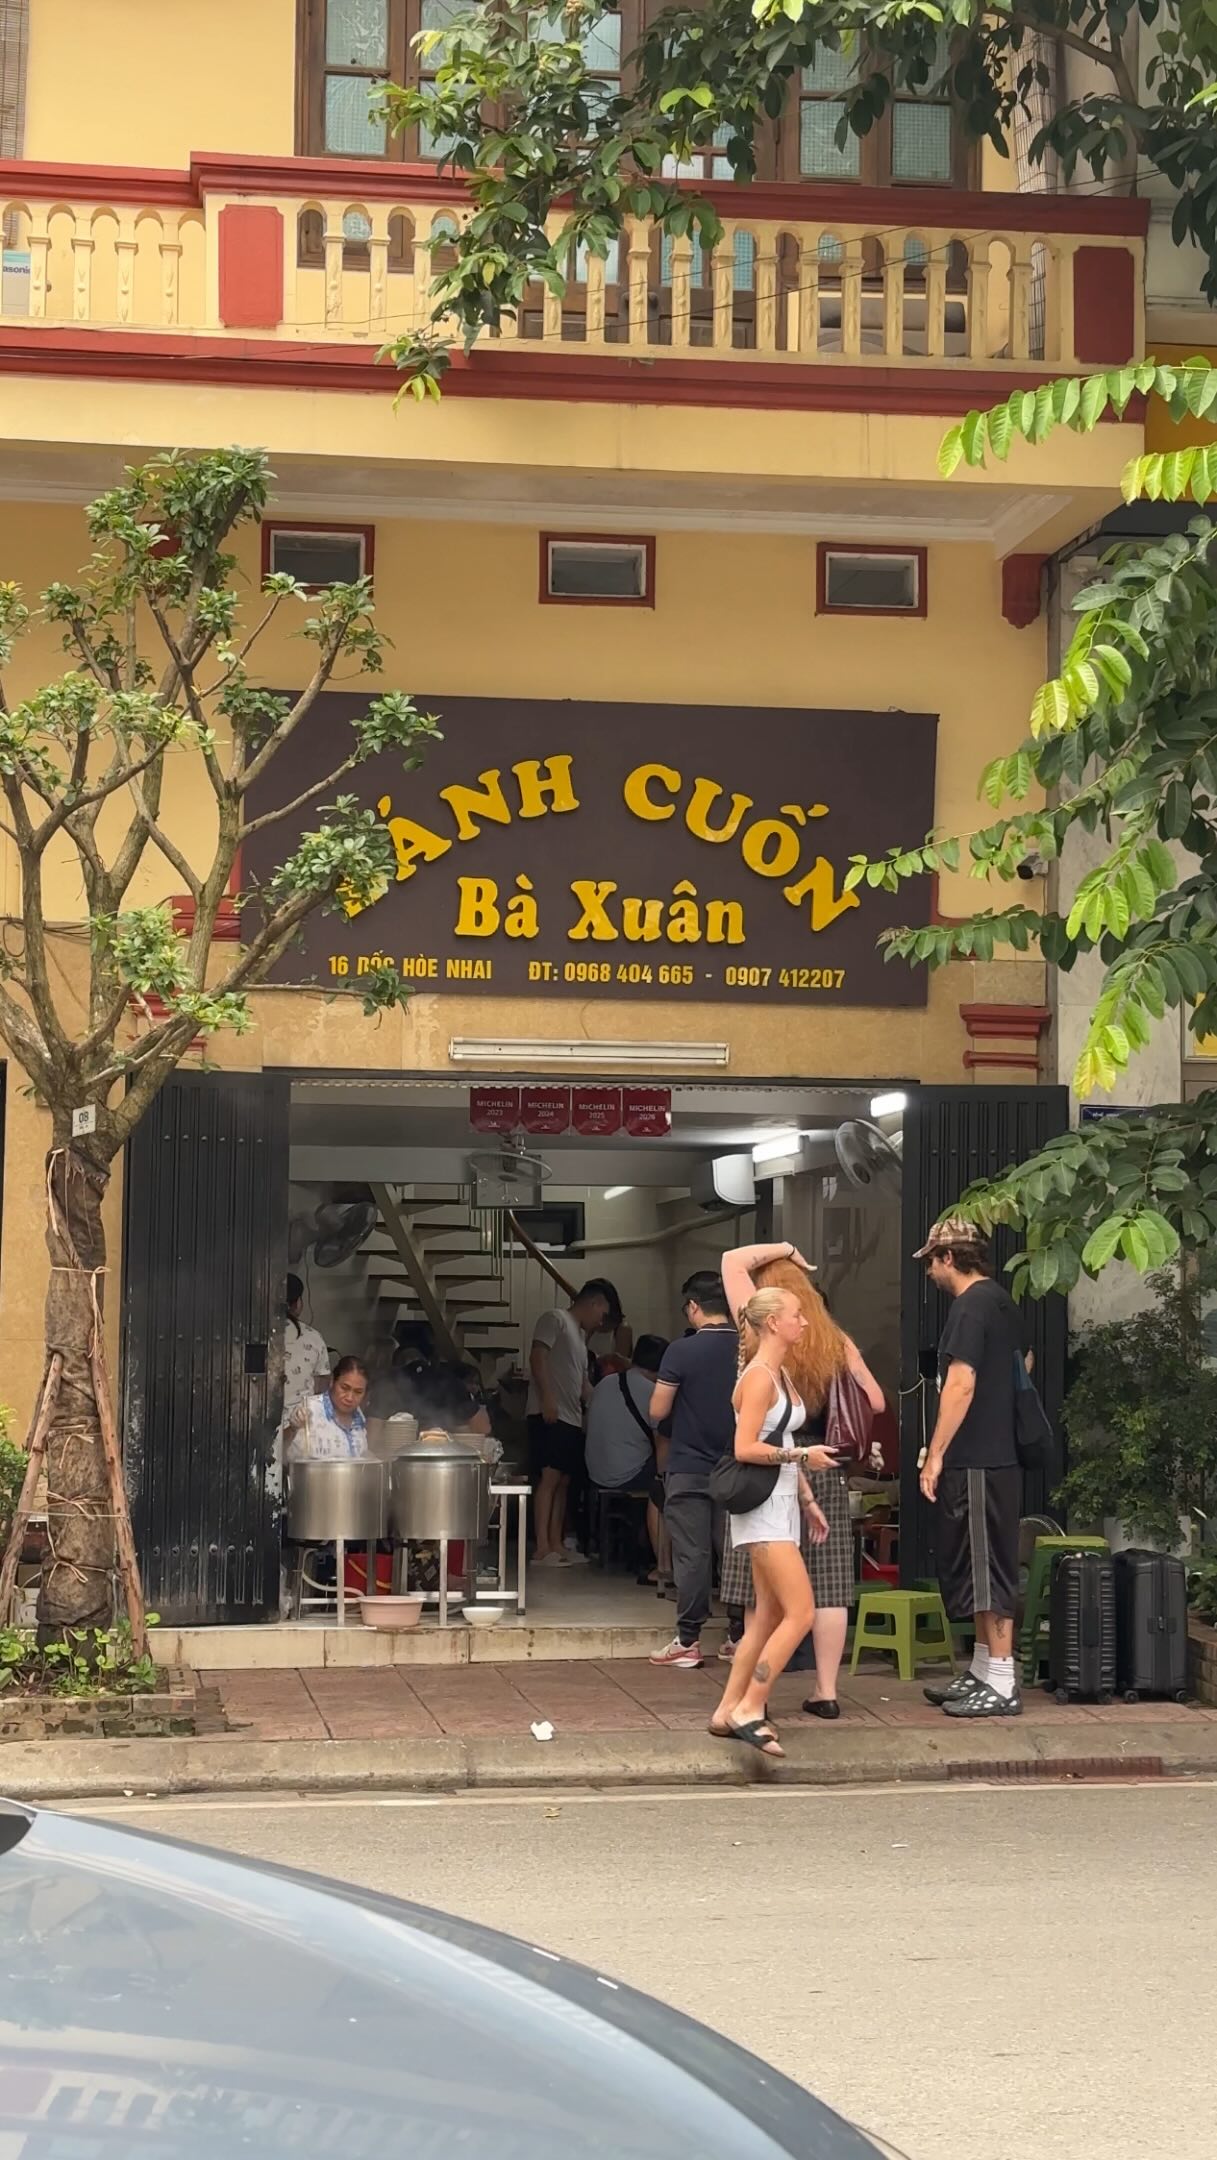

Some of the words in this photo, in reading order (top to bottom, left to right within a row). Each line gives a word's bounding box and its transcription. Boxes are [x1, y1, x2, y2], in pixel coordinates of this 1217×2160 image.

[624, 763, 860, 931] CUỐN
[455, 874, 540, 940] Bà
[568, 879, 746, 944] Xuân
[328, 956, 349, 976] 16
[403, 954, 438, 978] HÒE
[446, 959, 493, 979] NHAI
[528, 961, 558, 981] ĐT:
[564, 962, 611, 983] 0968
[616, 963, 653, 984] 404
[658, 965, 694, 985] 665
[725, 966, 772, 987] 0907
[778, 967, 847, 989] 412207
[476, 1100, 513, 1108] MICHELIN
[578, 1103, 615, 1111] MICHELIN
